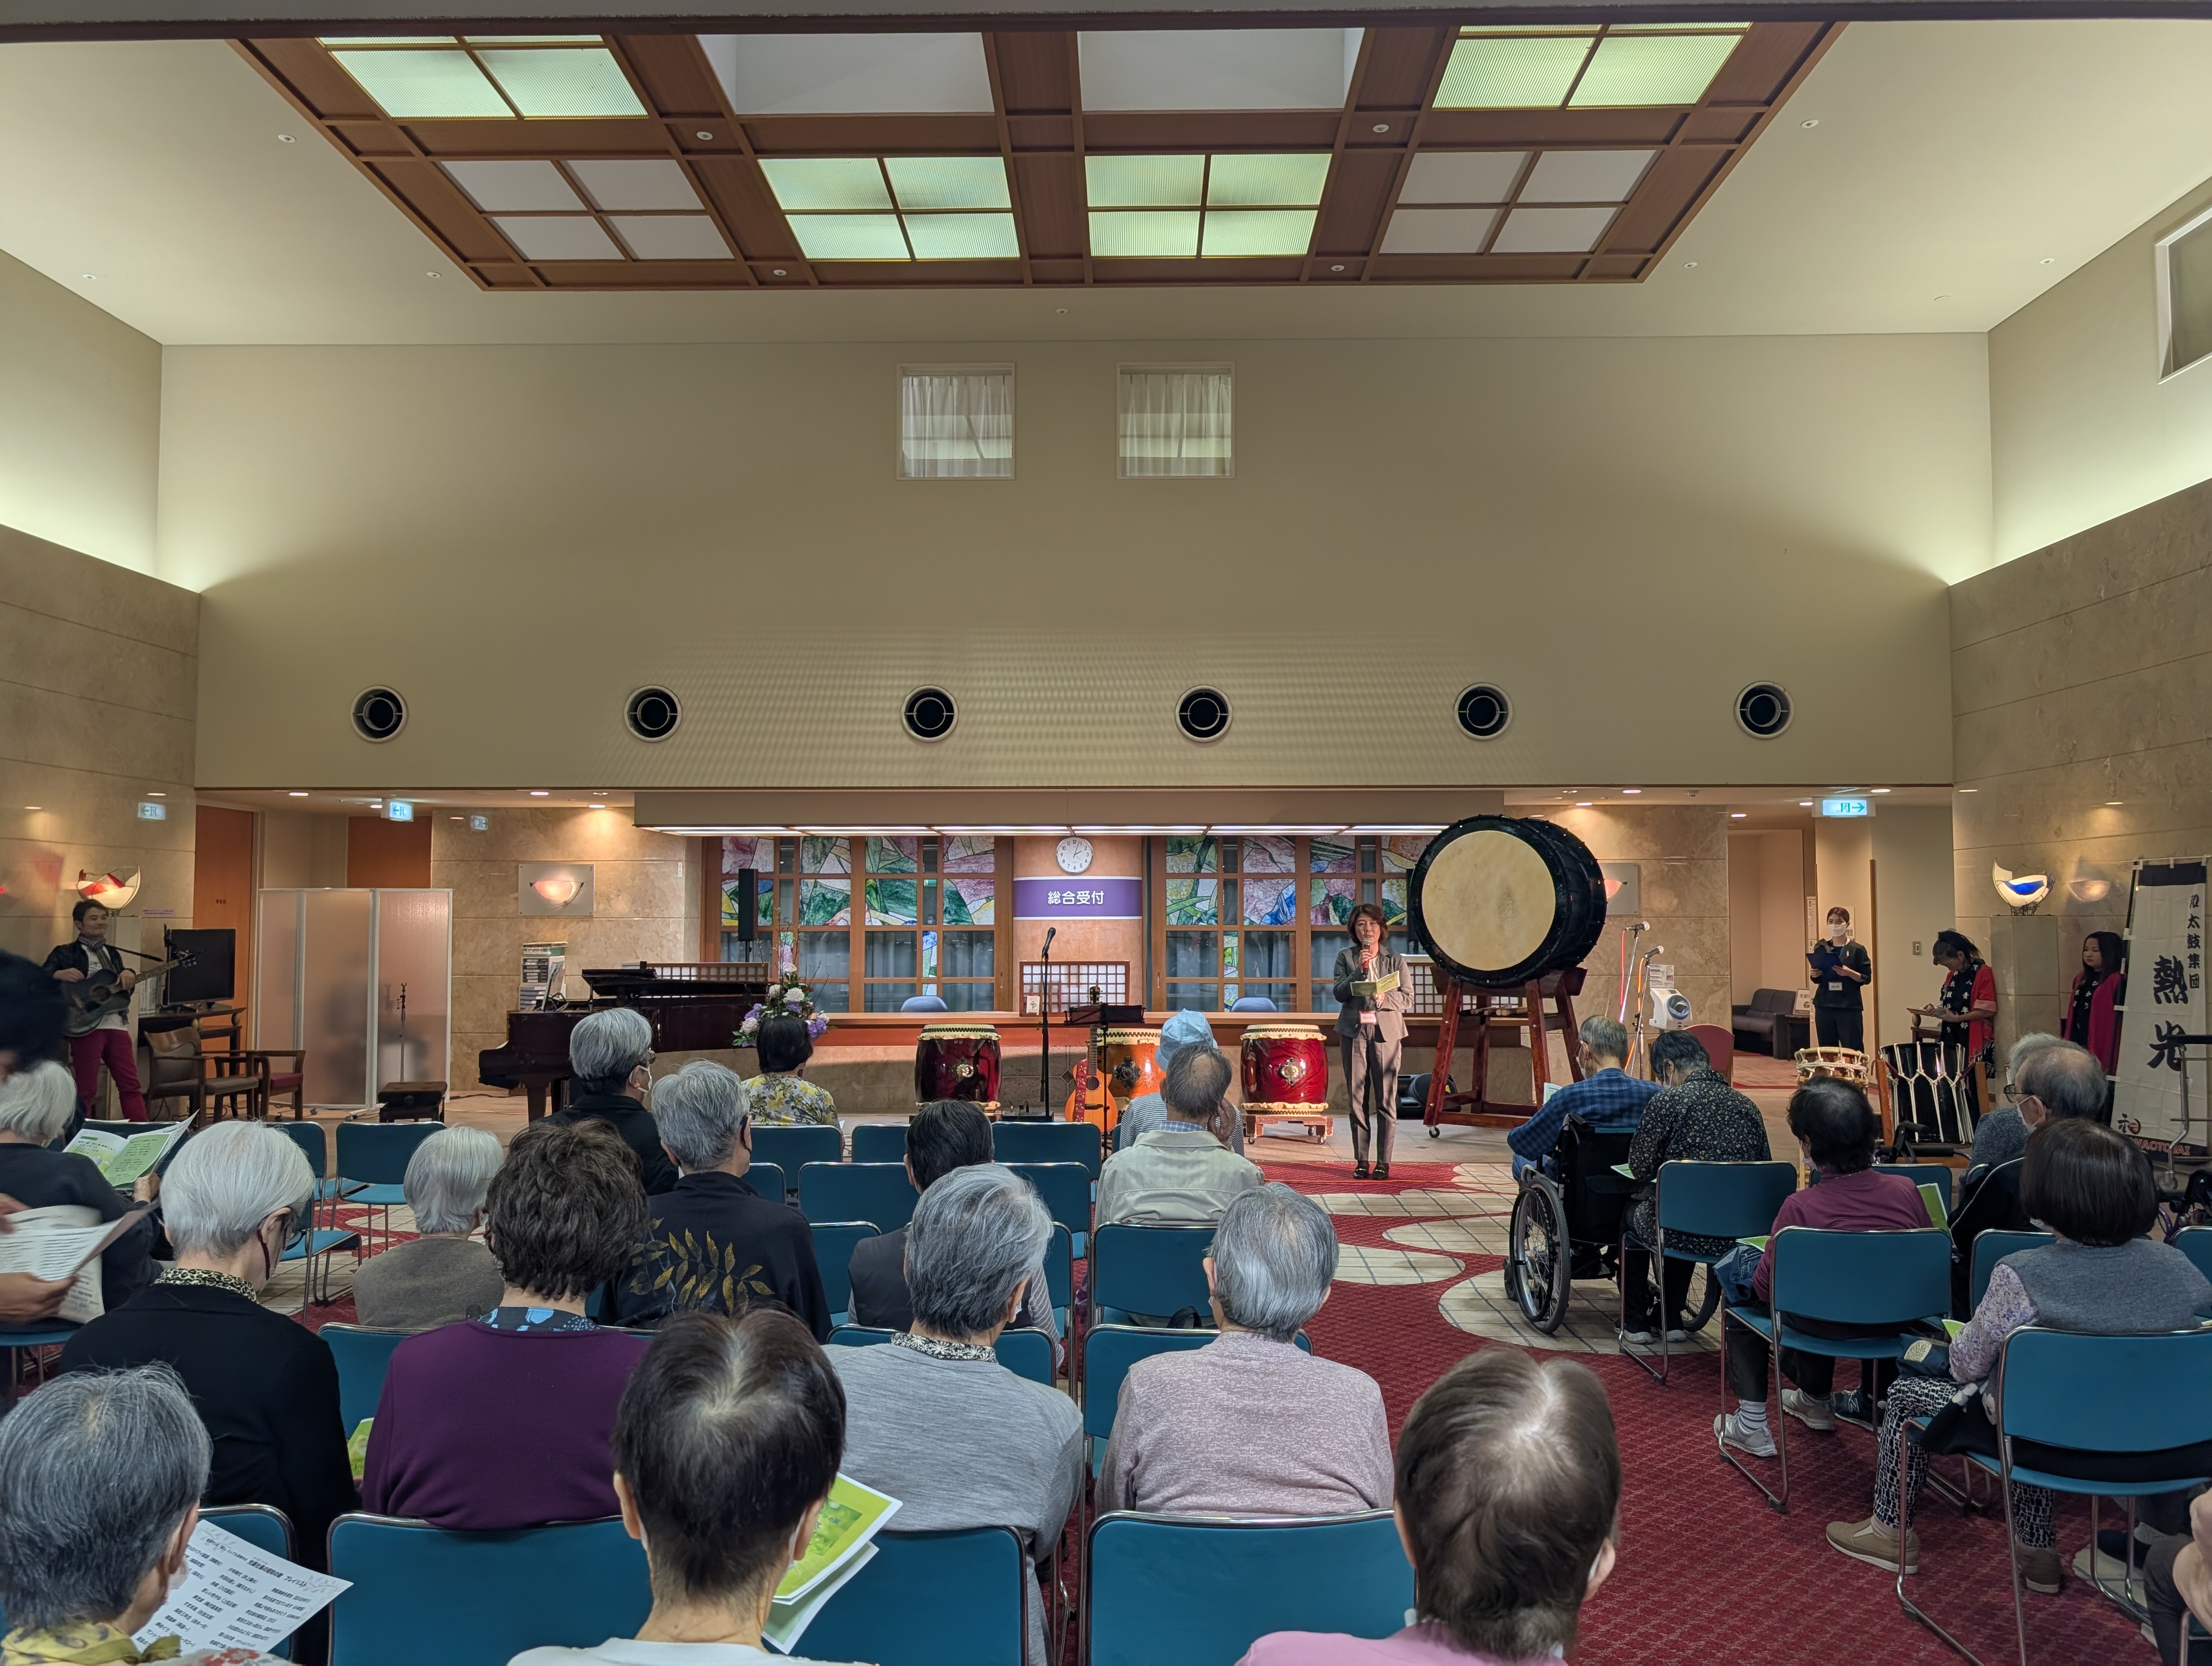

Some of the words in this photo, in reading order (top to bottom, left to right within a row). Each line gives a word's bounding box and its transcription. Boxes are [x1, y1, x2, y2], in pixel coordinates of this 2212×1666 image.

[1047, 890, 1104, 905] 総合受付
[2187, 894, 2201, 989] 和太鼓集団
